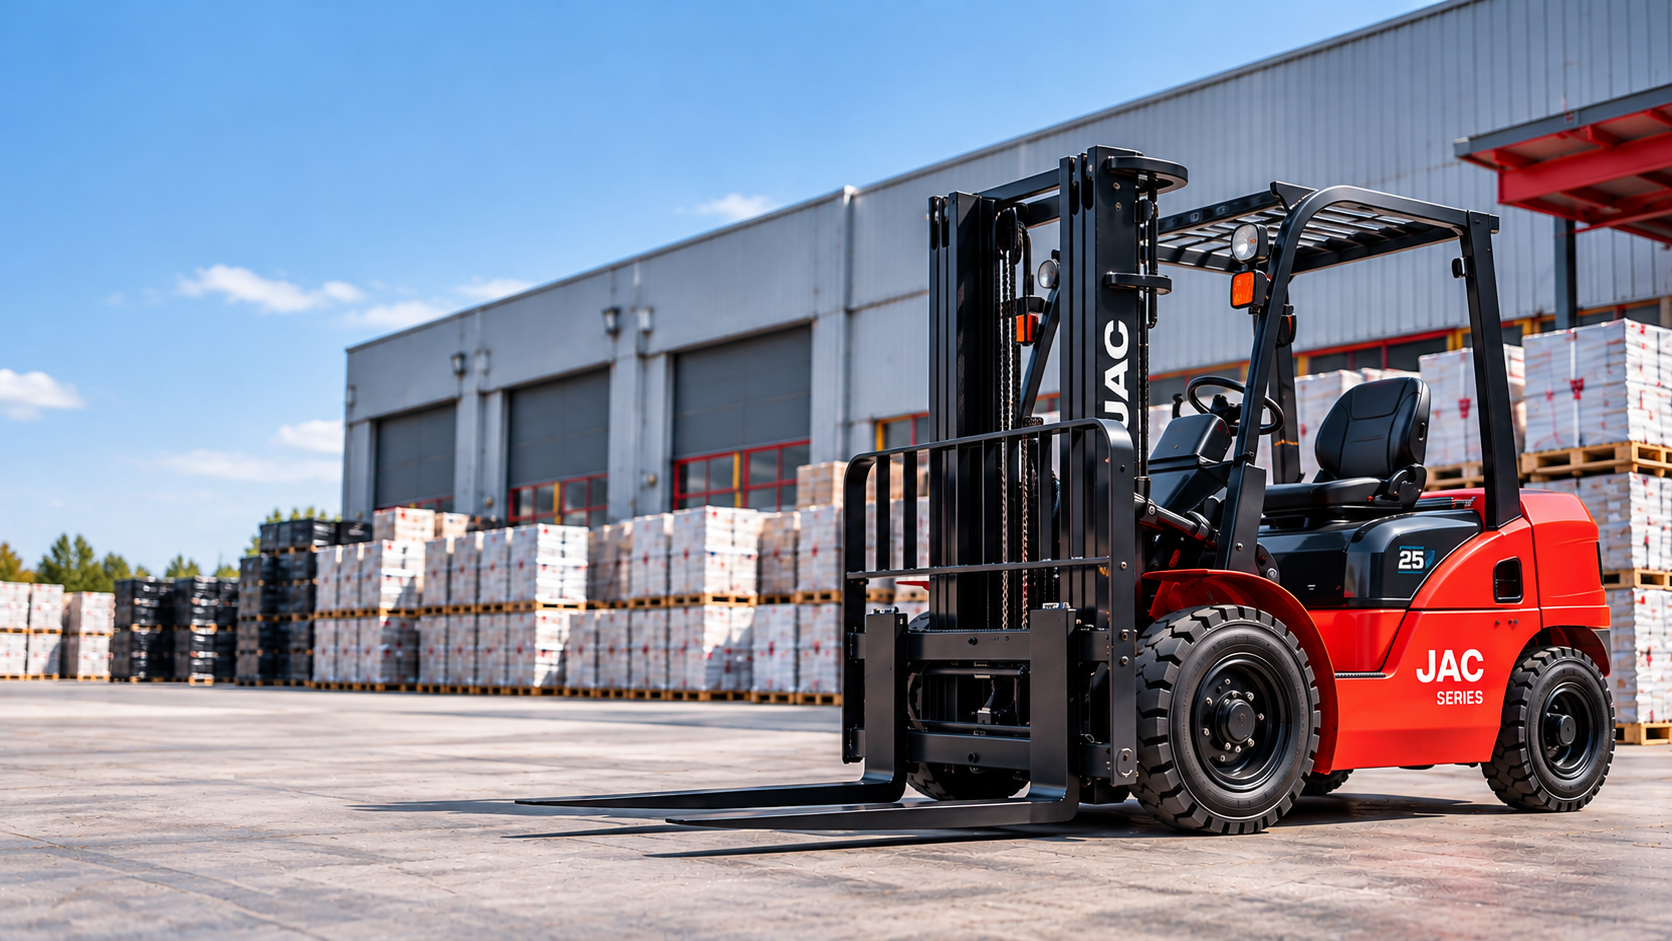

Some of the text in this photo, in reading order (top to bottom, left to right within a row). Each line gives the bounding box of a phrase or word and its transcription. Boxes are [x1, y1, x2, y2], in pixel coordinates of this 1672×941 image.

[1104, 320, 1129, 429] JAC
[1398, 550, 1425, 570] 25
[1416, 649, 1484, 683] JAC
[1436, 690, 1484, 705] SERIES
